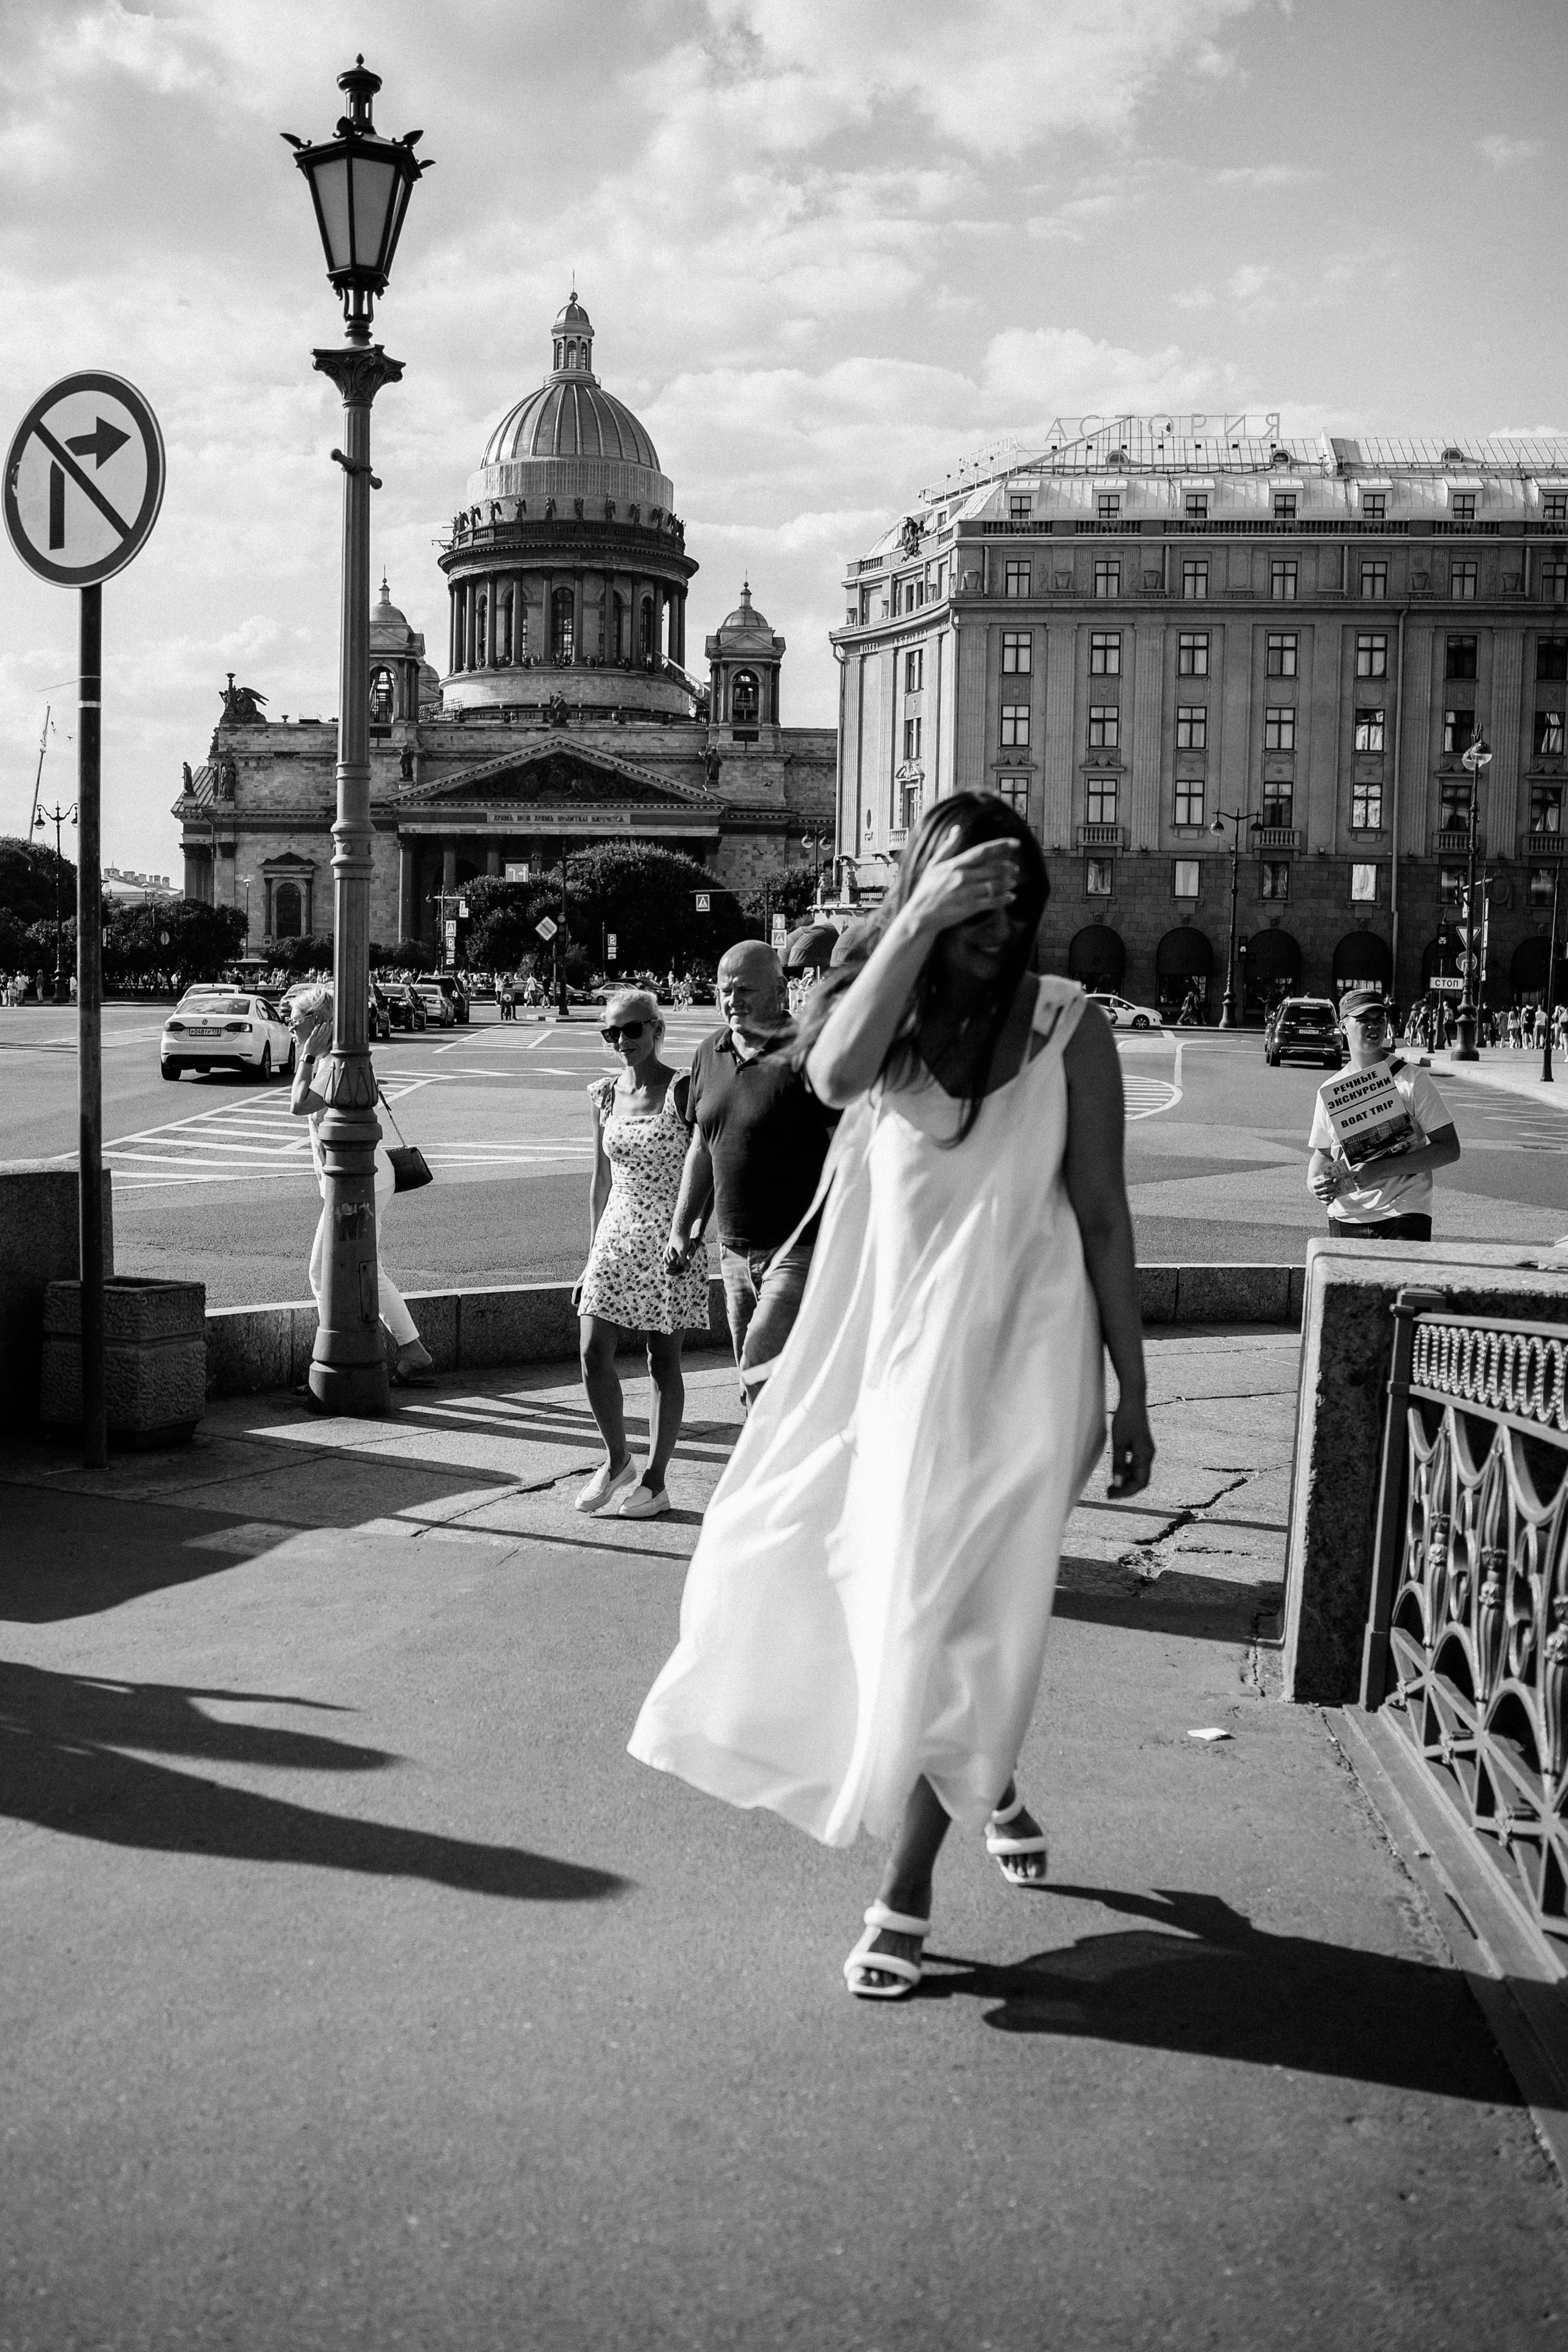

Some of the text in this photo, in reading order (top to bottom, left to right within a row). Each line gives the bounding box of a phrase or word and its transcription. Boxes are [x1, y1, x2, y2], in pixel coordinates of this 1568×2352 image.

[1044, 413, 1280, 441] АСТОРИЯ
[1327, 1076, 1392, 1110] ЭКСКУРСИИ
[1333, 1071, 1378, 1096] РЕЧНЫЕ
[1340, 1099, 1394, 1128] BOAT TRIP
